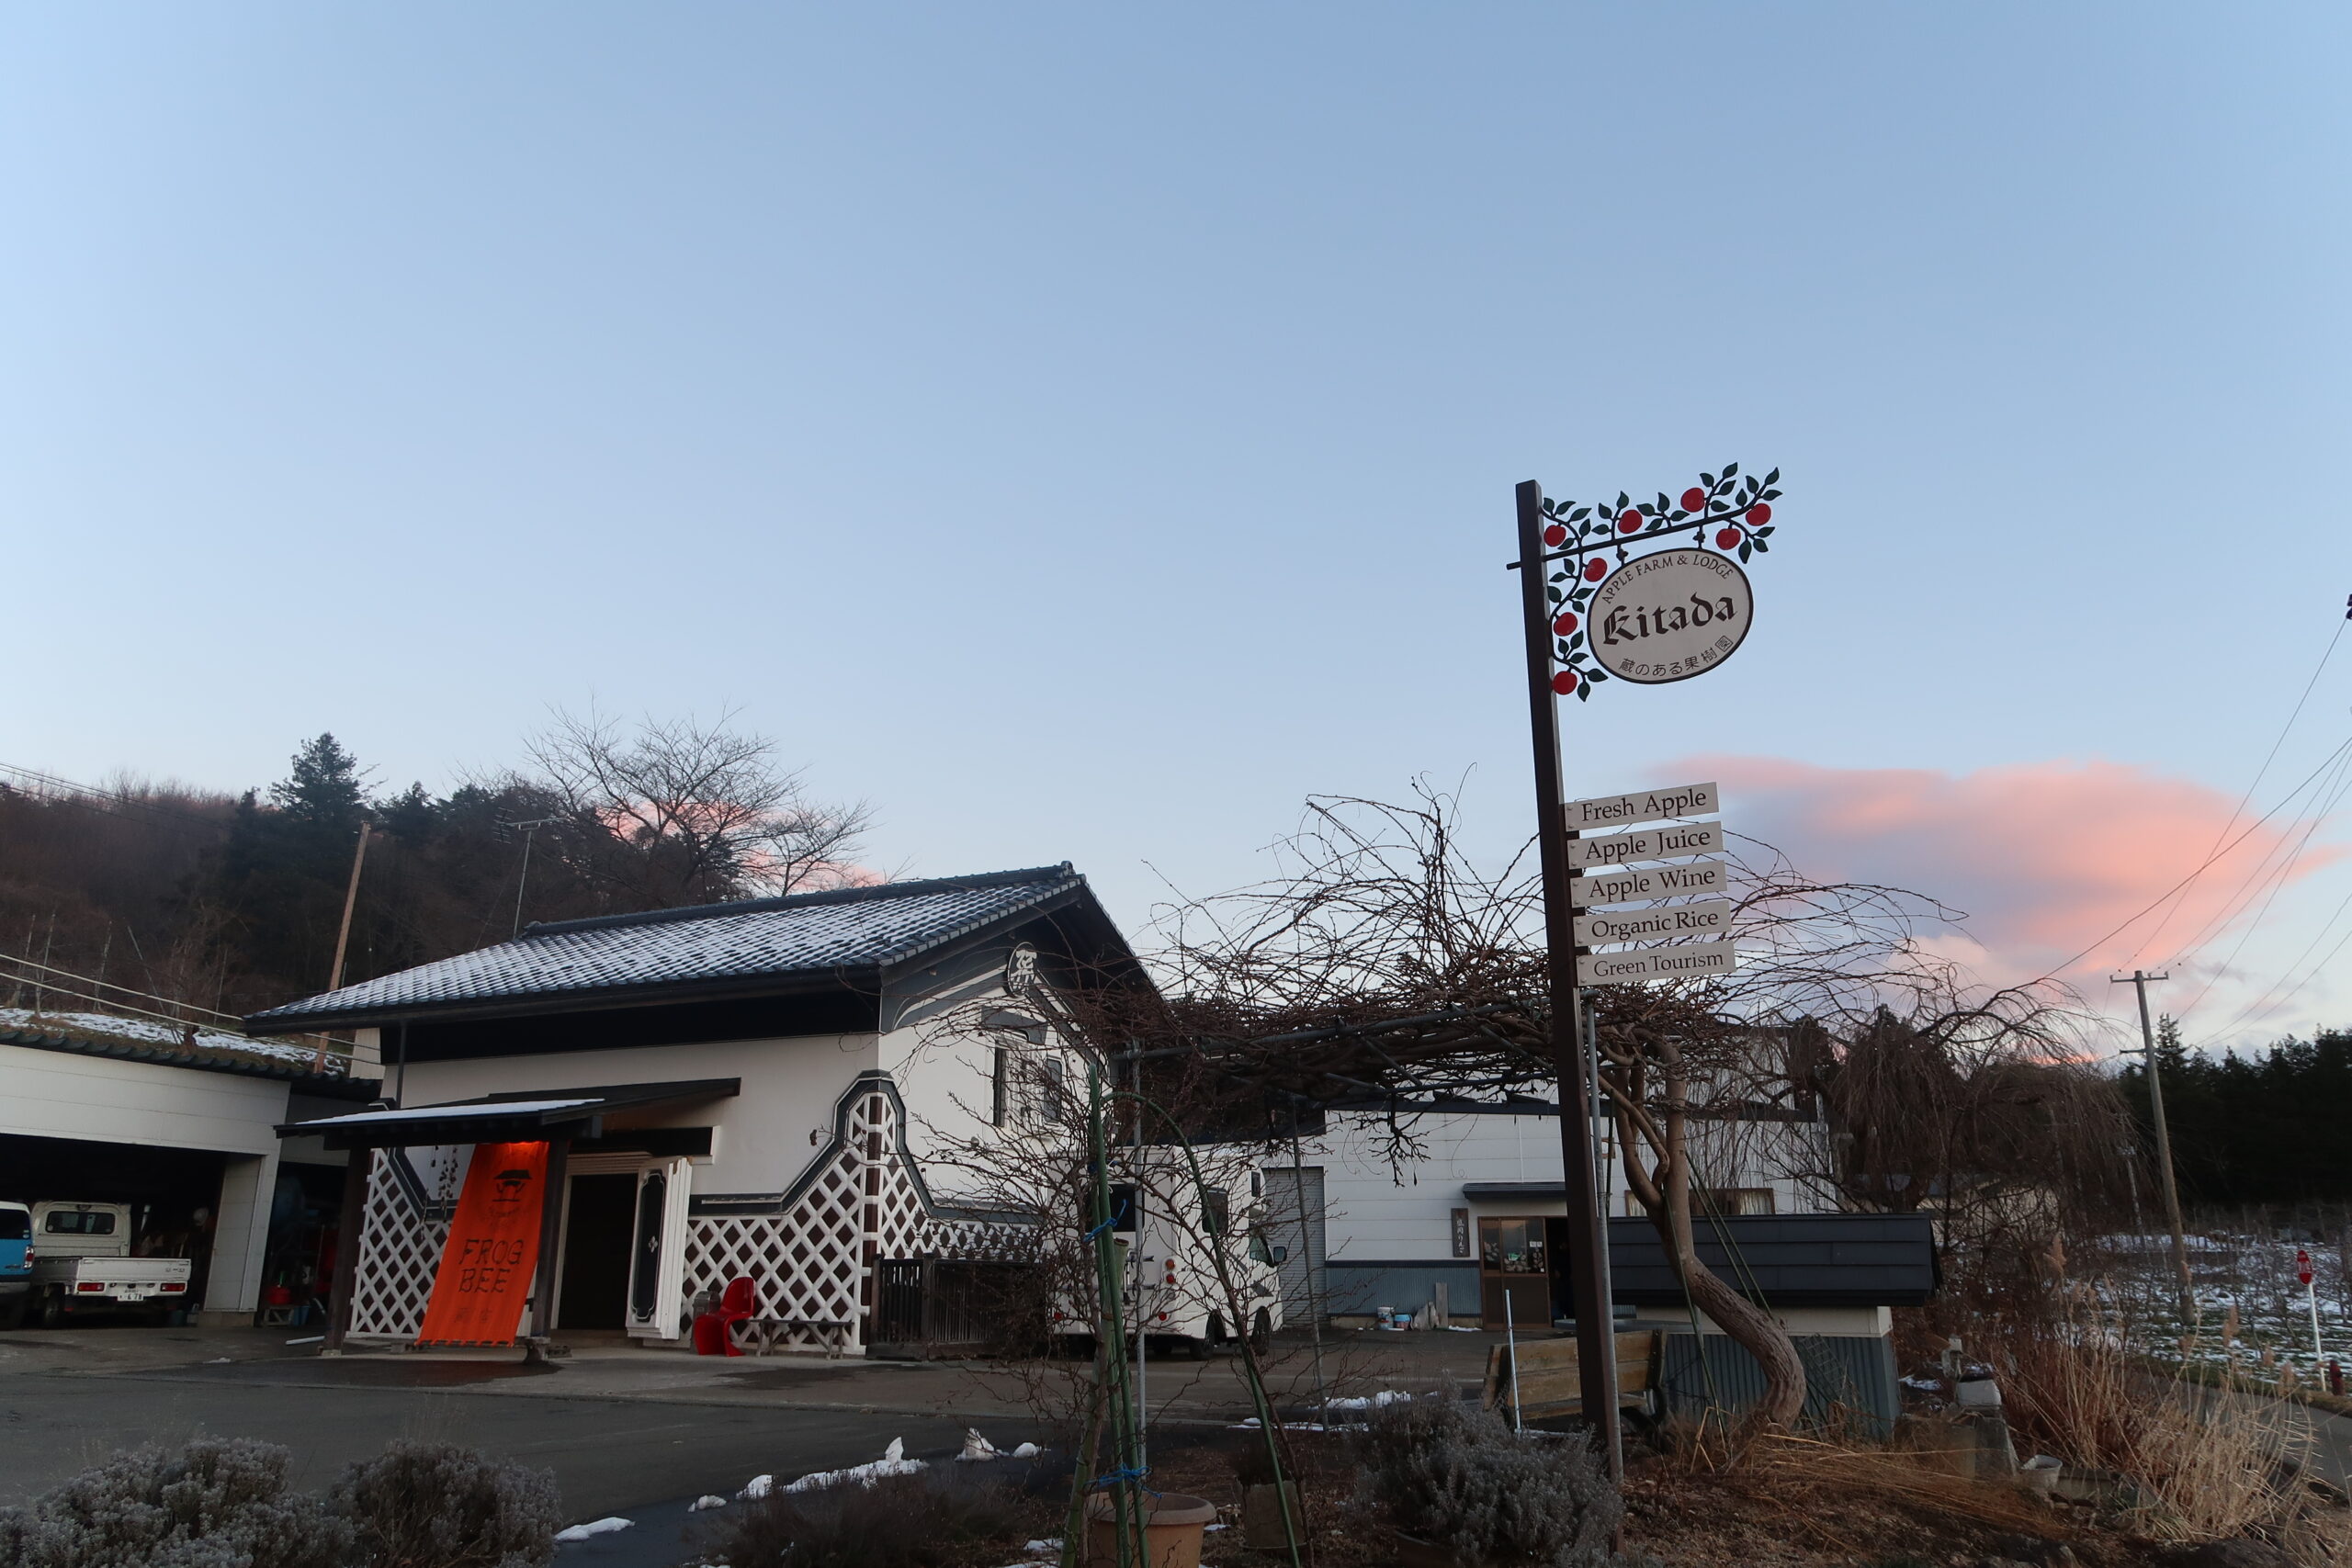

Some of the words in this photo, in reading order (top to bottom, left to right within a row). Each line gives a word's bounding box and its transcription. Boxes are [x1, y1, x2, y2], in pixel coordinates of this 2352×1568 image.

[1601, 570, 1634, 604] APPLE
[1635, 556, 1673, 577] FARM
[1677, 554, 1688, 565] &
[1692, 554, 1734, 581] LODGE
[1602, 592, 1739, 646] Kitada
[1618, 635, 1734, 677] 蔵のある果樹園
[1581, 797, 1635, 821] Fresh
[1644, 788, 1707, 818] Apple
[1585, 835, 1646, 864] Apple
[1657, 829, 1711, 856] Juice
[1589, 874, 1650, 903] Apple
[1658, 868, 1715, 888] Wine
[1591, 914, 1671, 941] Organic
[1675, 910, 1719, 930] Rice
[1594, 960, 1647, 977] Green
[1649, 952, 1724, 972] Tourism
[458, 1238, 525, 1265] FROG
[458, 1268, 512, 1293] BEE
